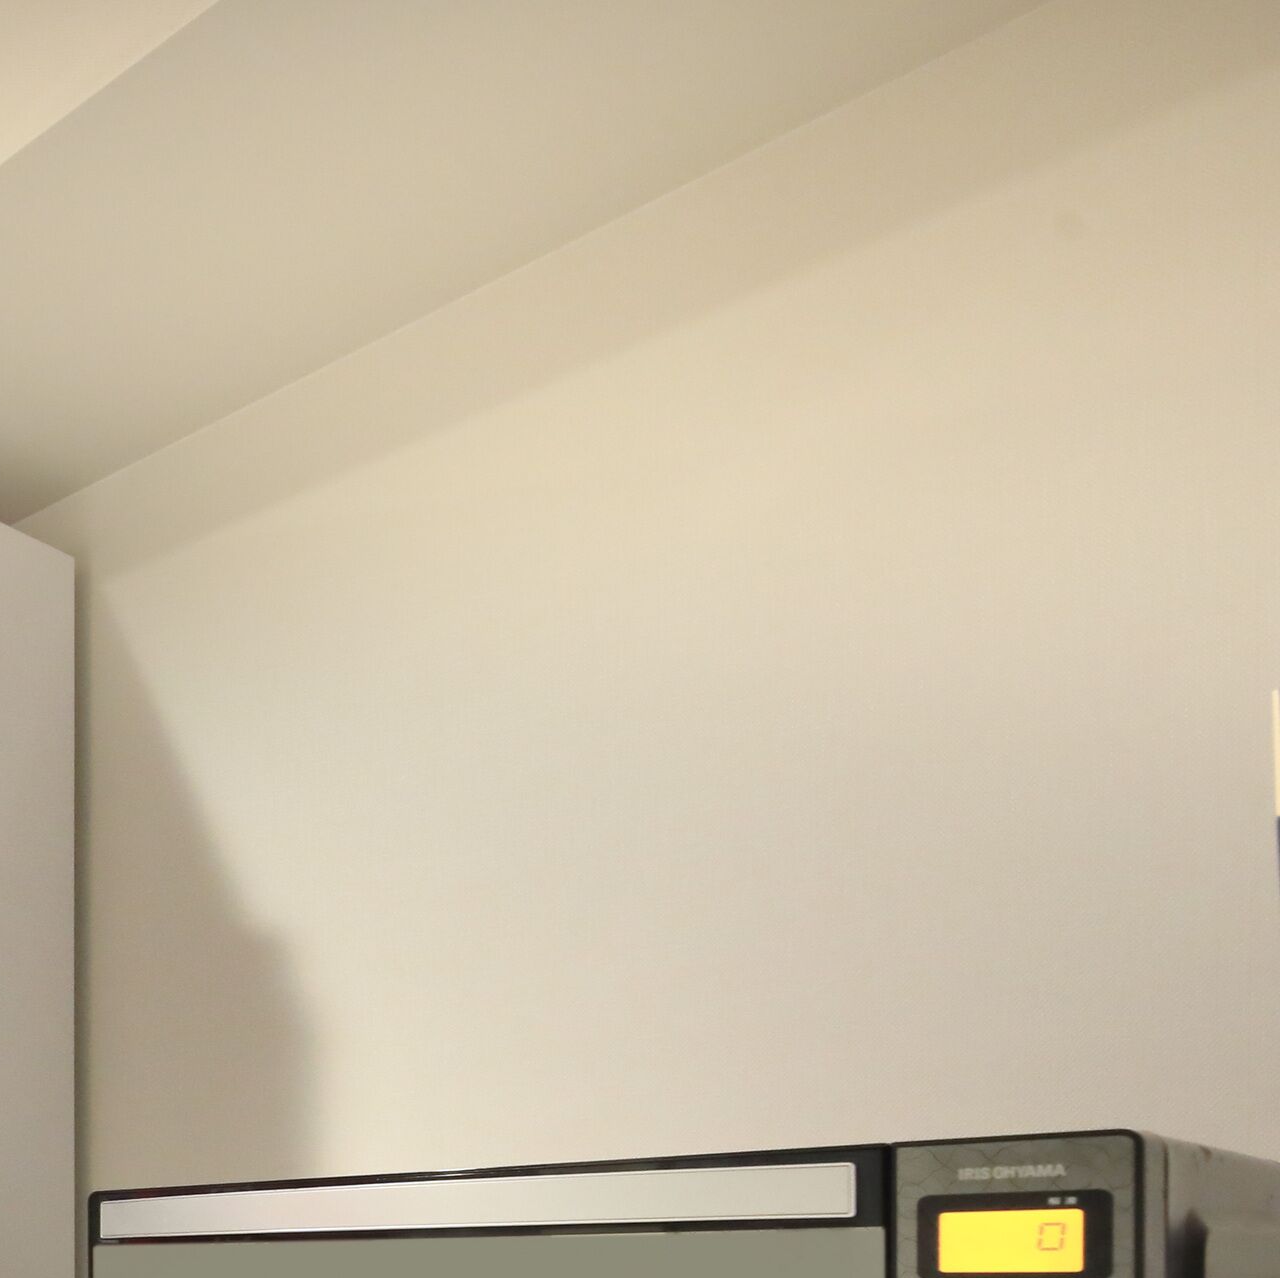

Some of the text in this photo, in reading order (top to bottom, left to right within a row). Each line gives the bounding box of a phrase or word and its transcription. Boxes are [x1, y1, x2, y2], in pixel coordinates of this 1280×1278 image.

[957, 1163, 1067, 1181] IRIS OHYAMA
[1037, 1221, 1067, 1252] 0
